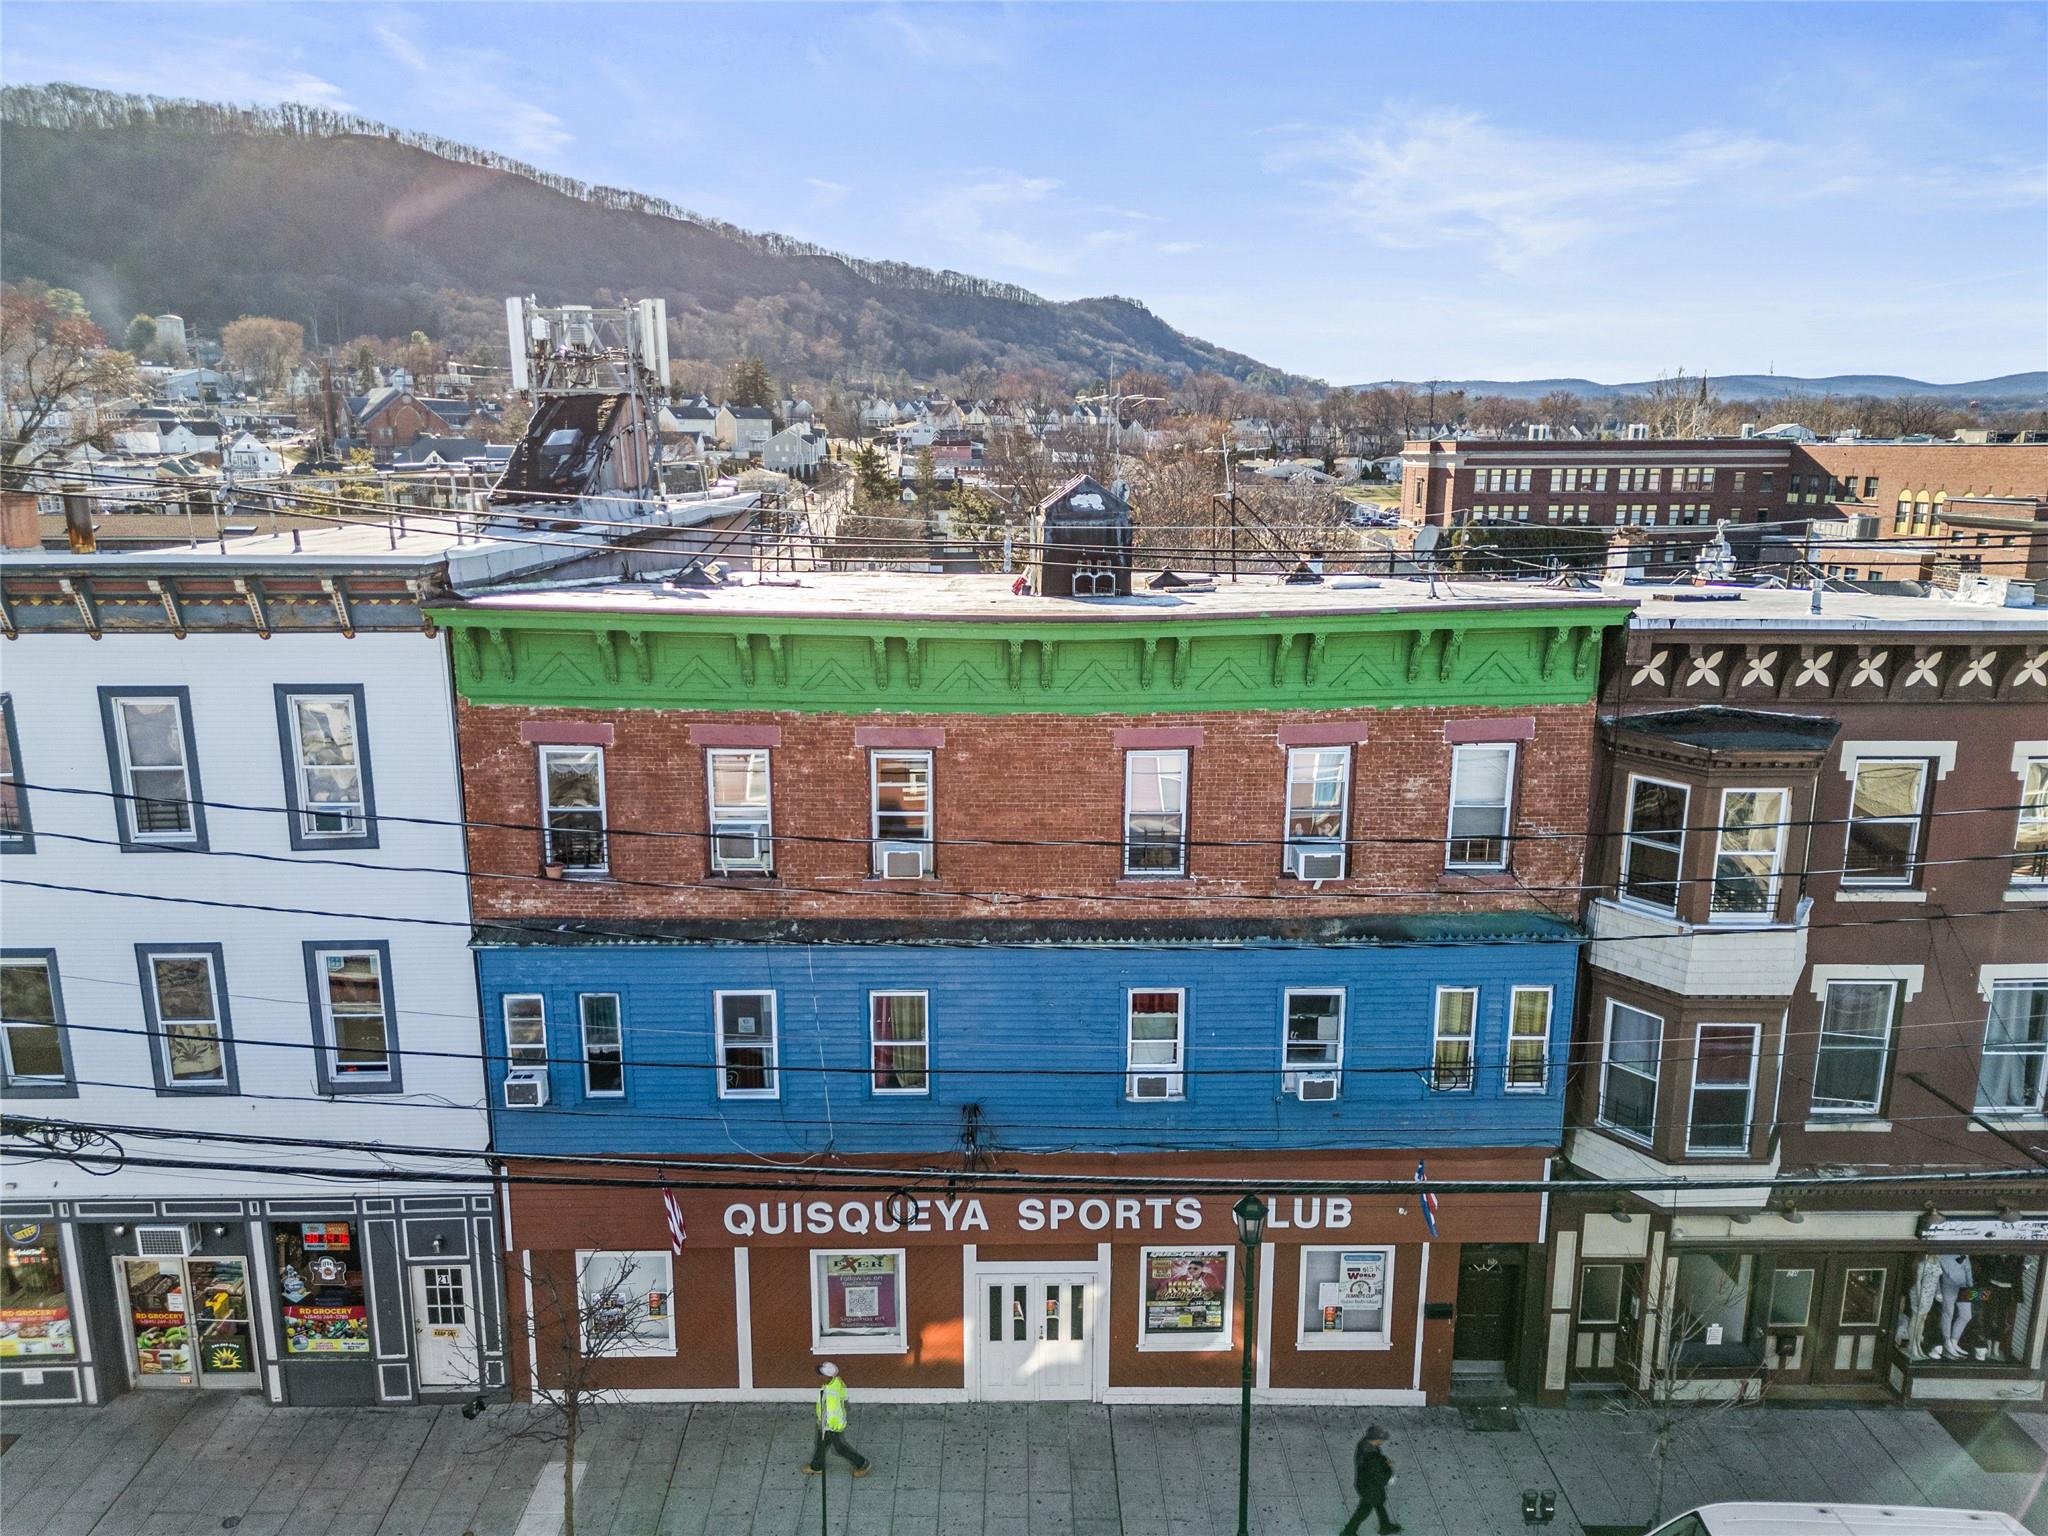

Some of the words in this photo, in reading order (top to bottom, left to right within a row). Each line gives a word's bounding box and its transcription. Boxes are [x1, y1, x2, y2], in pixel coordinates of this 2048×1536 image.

[723, 1199, 989, 1237] QUISQUEYA
[1018, 1198, 1202, 1231] SPORTS
[1232, 1197, 1353, 1230] LUB
[438, 1275, 449, 1285] 21
[1347, 1272, 1377, 1280] WORLD
[15, 1309, 57, 1317] GROCERY
[299, 1307, 312, 1315] RD
[312, 1307, 352, 1315] GROCERY
